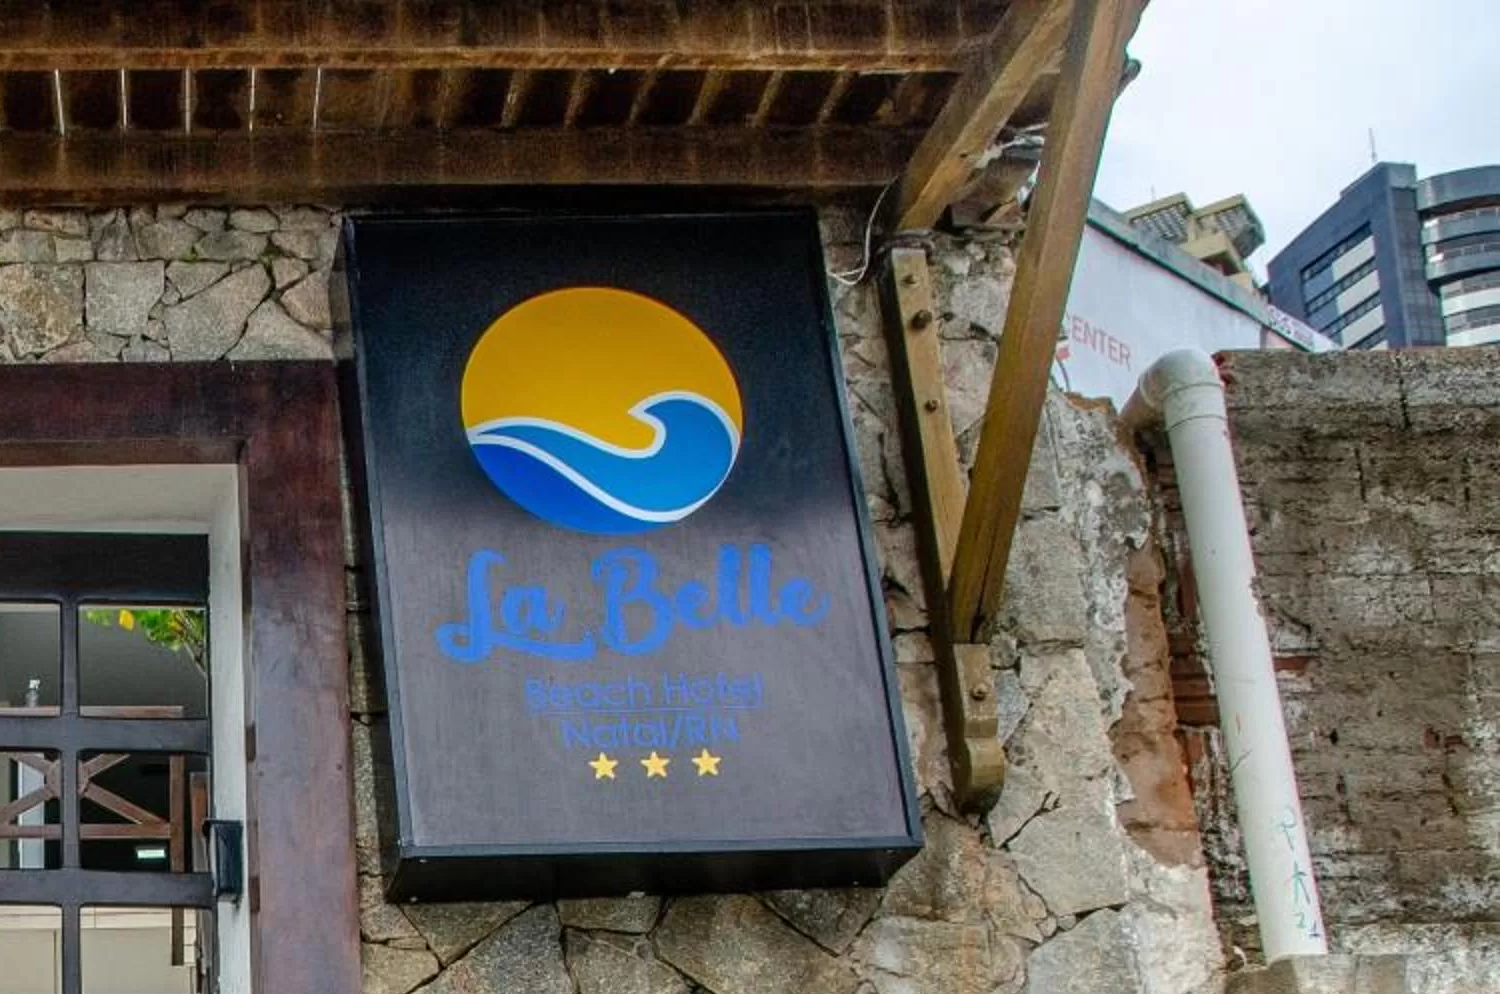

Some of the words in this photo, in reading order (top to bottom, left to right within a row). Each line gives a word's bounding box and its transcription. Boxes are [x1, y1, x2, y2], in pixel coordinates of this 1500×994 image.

[1065, 311, 1132, 373] ENTER
[434, 548, 595, 664] La
[590, 543, 831, 657] Belle
[525, 673, 650, 713] Beach
[663, 671, 765, 711] Hotel
[561, 713, 741, 749] Natal/RN
